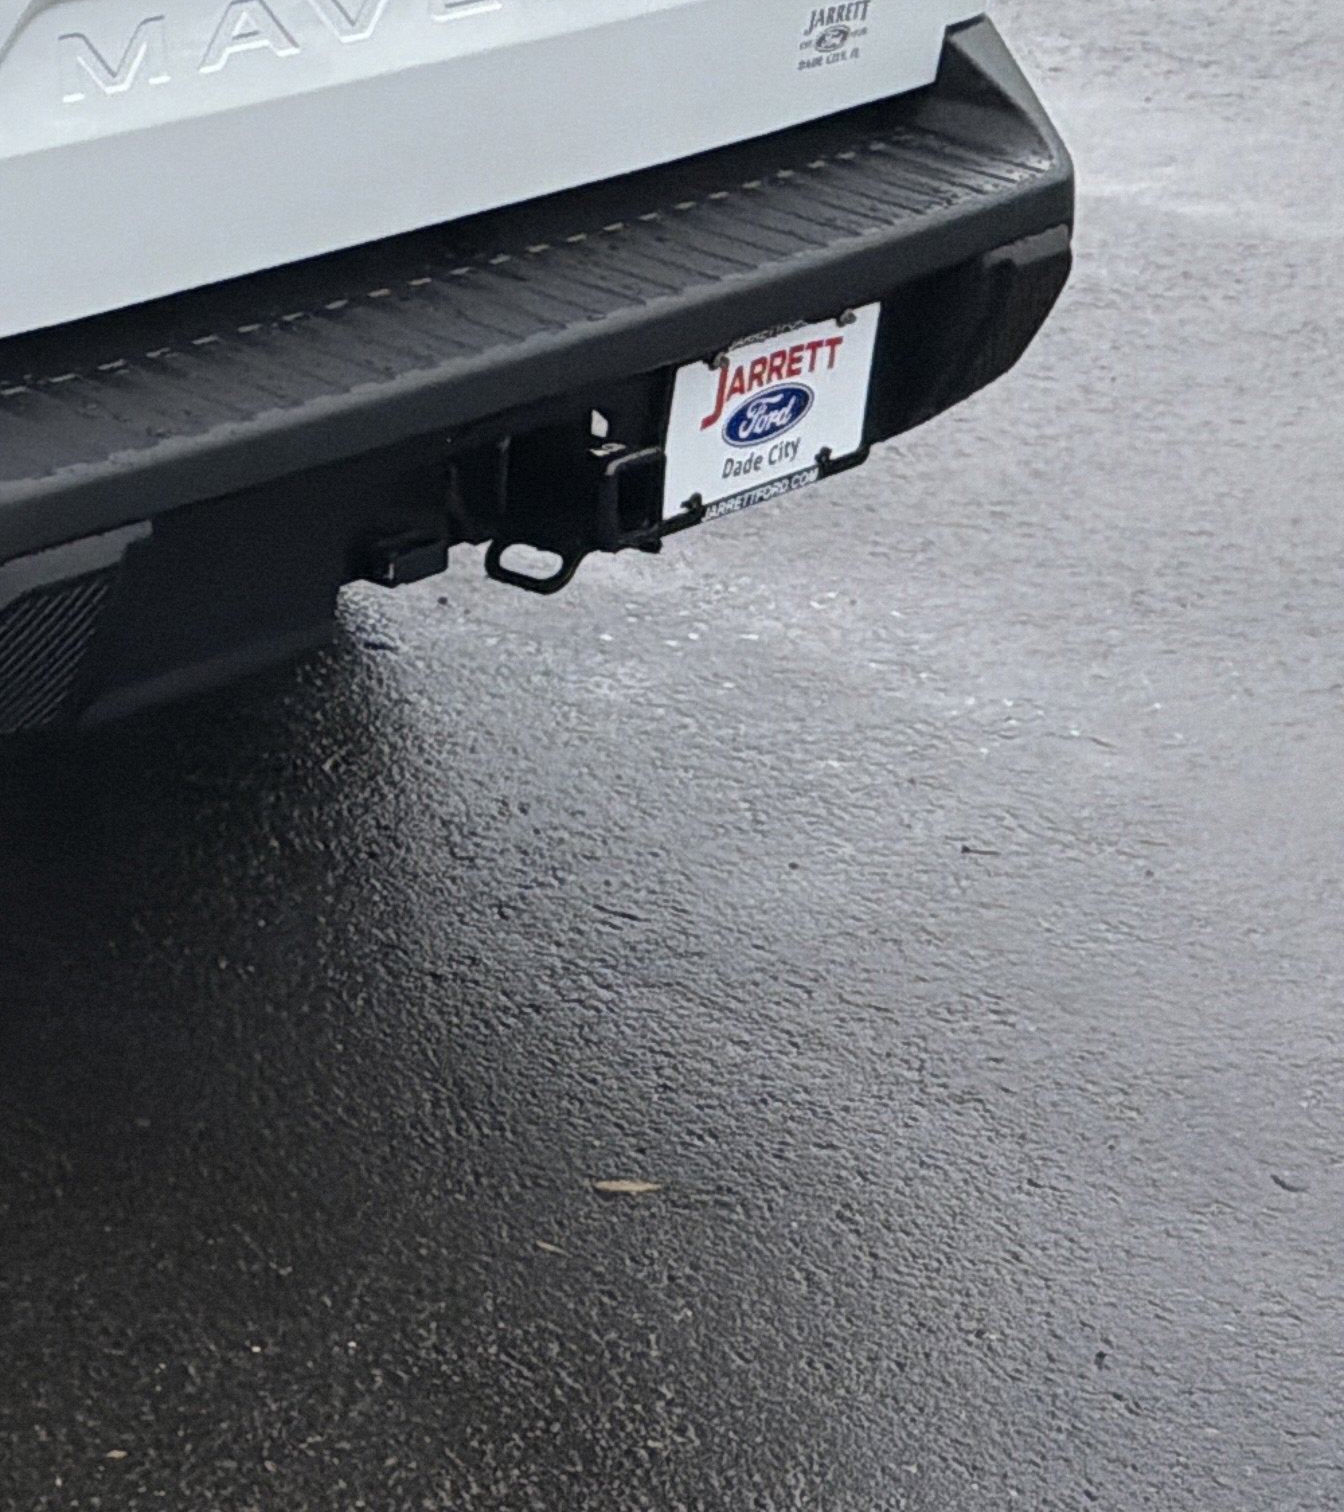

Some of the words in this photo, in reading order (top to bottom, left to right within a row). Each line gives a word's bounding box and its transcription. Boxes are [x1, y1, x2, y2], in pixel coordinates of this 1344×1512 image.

[701, 335, 844, 430] JARRETT
[738, 391, 794, 438] Ford
[721, 452, 764, 479] Dade
[768, 437, 800, 466] City
